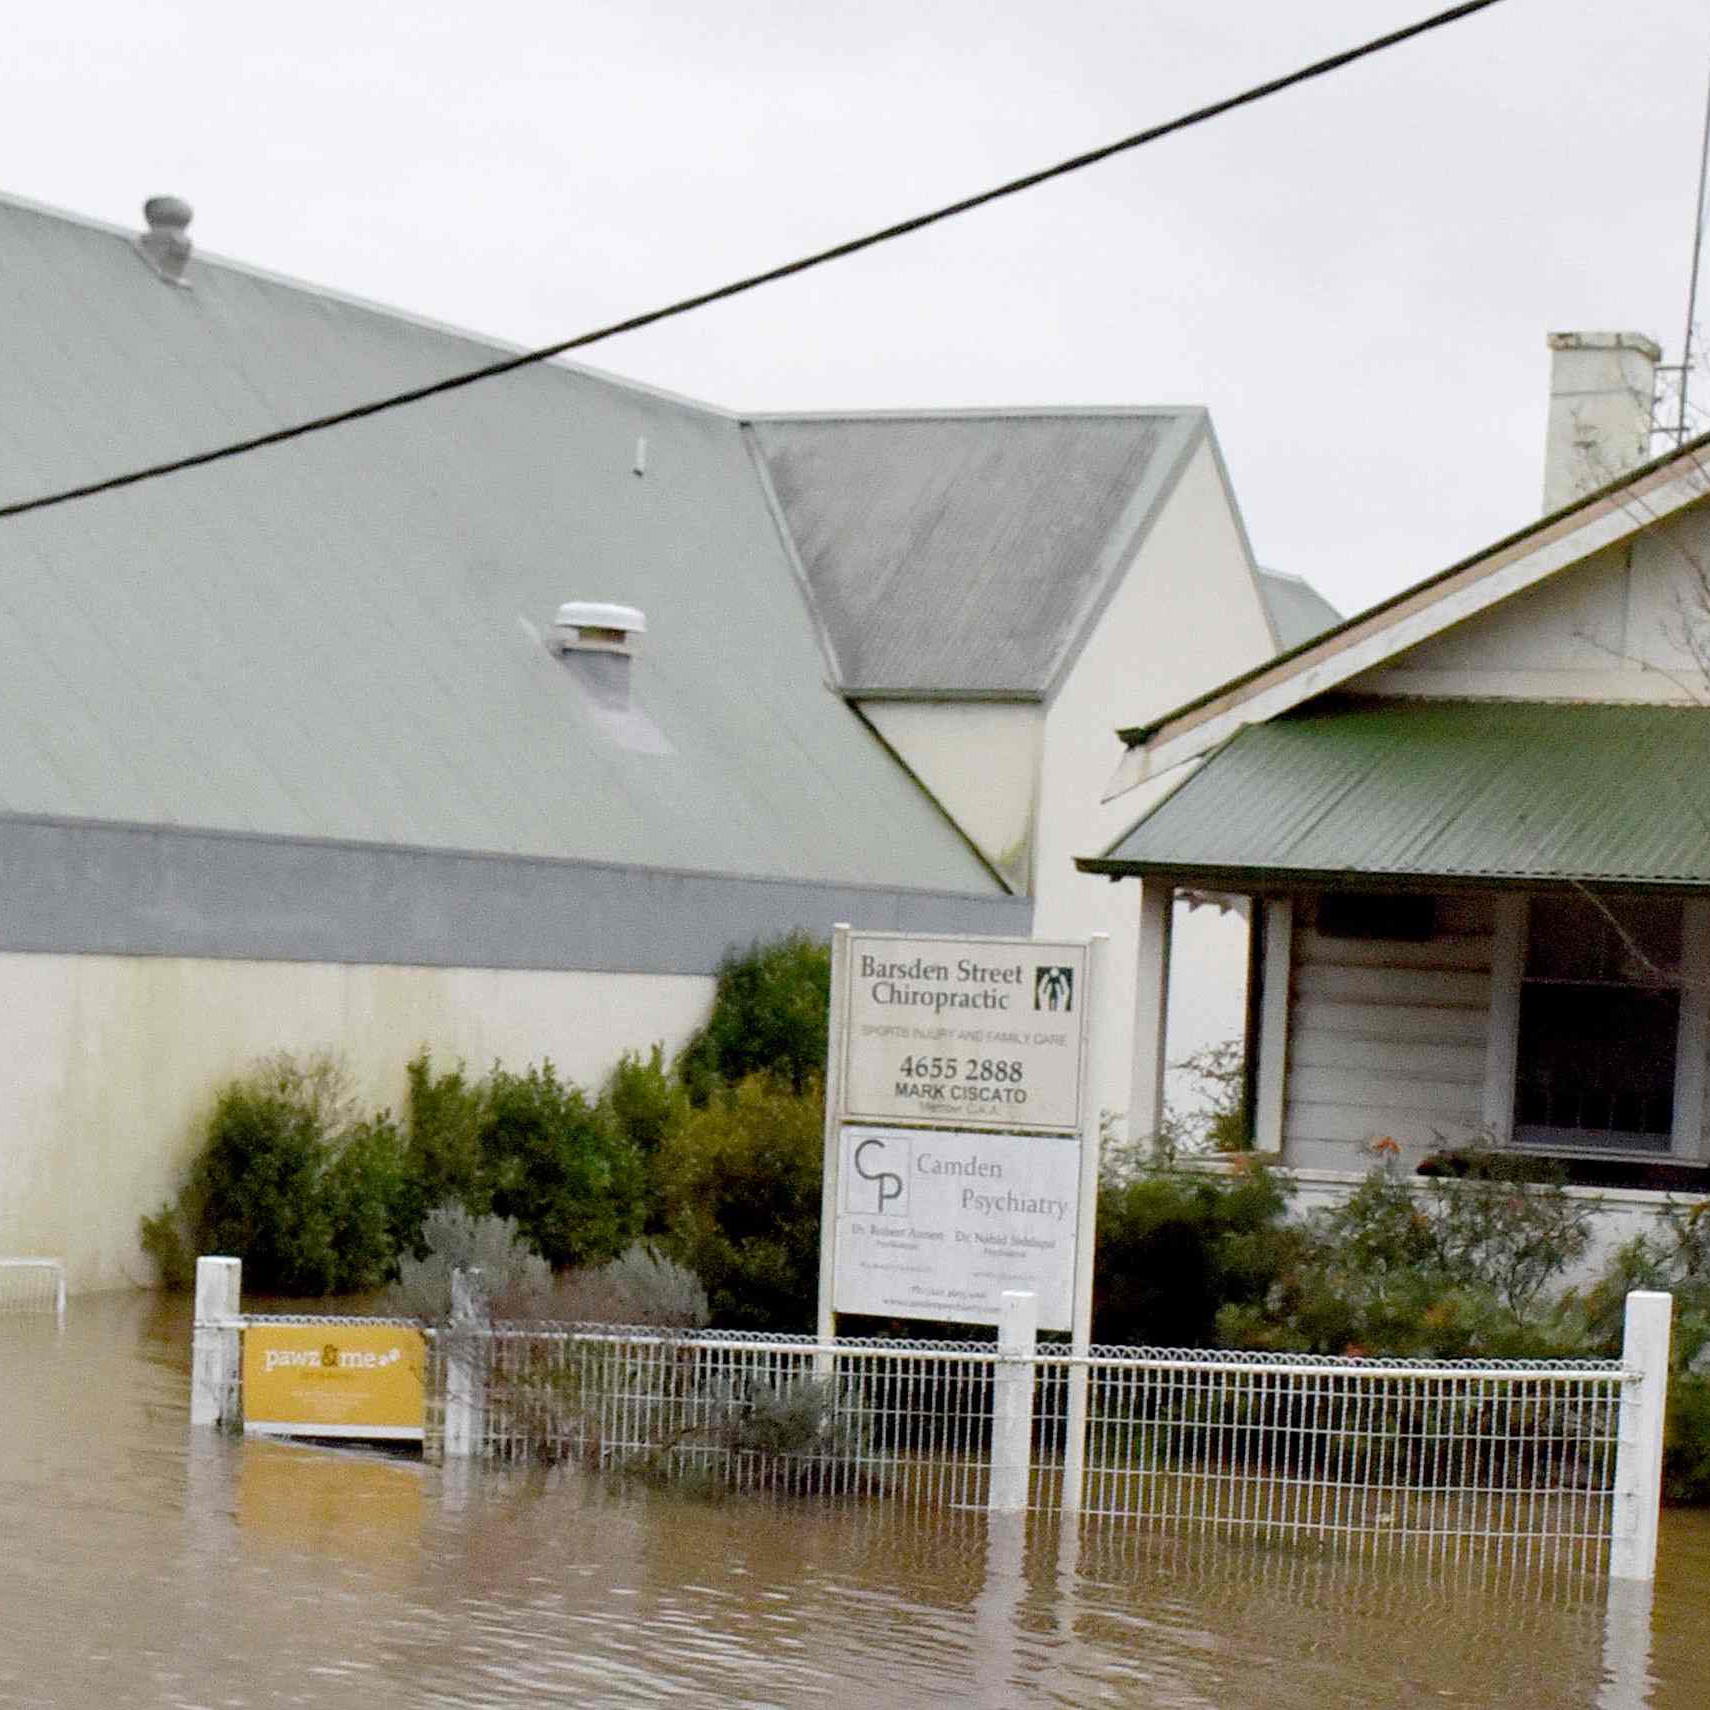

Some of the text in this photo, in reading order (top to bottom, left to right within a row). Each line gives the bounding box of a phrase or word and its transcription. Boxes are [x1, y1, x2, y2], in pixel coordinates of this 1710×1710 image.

[860, 953, 1024, 985] Barsden Street
[871, 981, 1010, 1015] Chiropractic
[957, 1029, 983, 1042] AND
[986, 1031, 1031, 1045] FAMILY
[1034, 1033, 1068, 1047] CARE
[899, 1055, 1024, 1083] 4655 2888
[894, 1082, 1028, 1104] MARK CISCATO
[916, 1153, 1003, 1178] Camden
[961, 1188, 1068, 1221] Psychiatry
